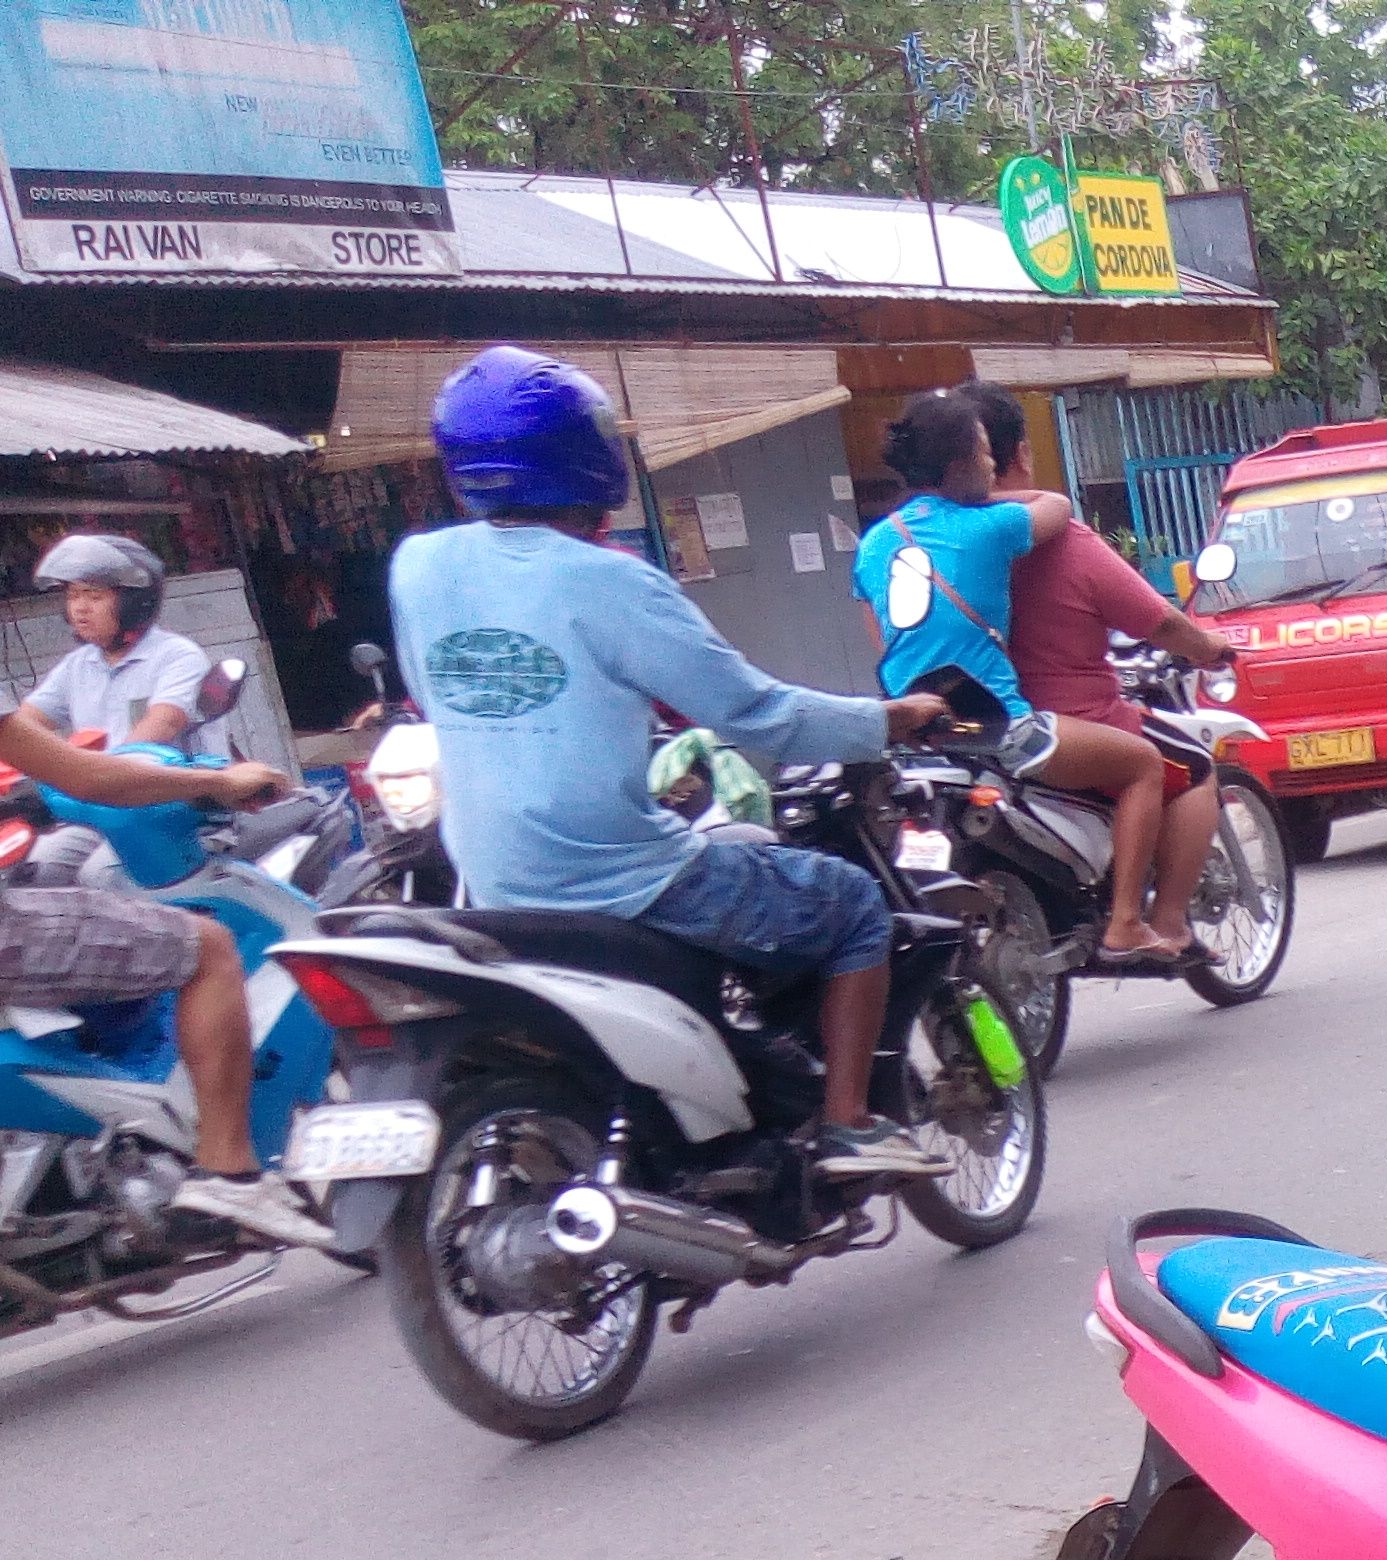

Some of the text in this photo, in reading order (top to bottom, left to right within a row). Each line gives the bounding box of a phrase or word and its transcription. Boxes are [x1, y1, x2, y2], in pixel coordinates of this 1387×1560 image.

[225, 94, 258, 113] NEW
[322, 143, 361, 164] EVEN
[30, 186, 114, 203] GOVERNMENT
[176, 190, 239, 206] CIGARETTE
[241, 192, 289, 207] SMOKING
[290, 196, 301, 208] IS
[1085, 195, 1153, 231] PAN DE
[331, 231, 424, 266] STORE
[1094, 243, 1174, 278] CORDOVA
